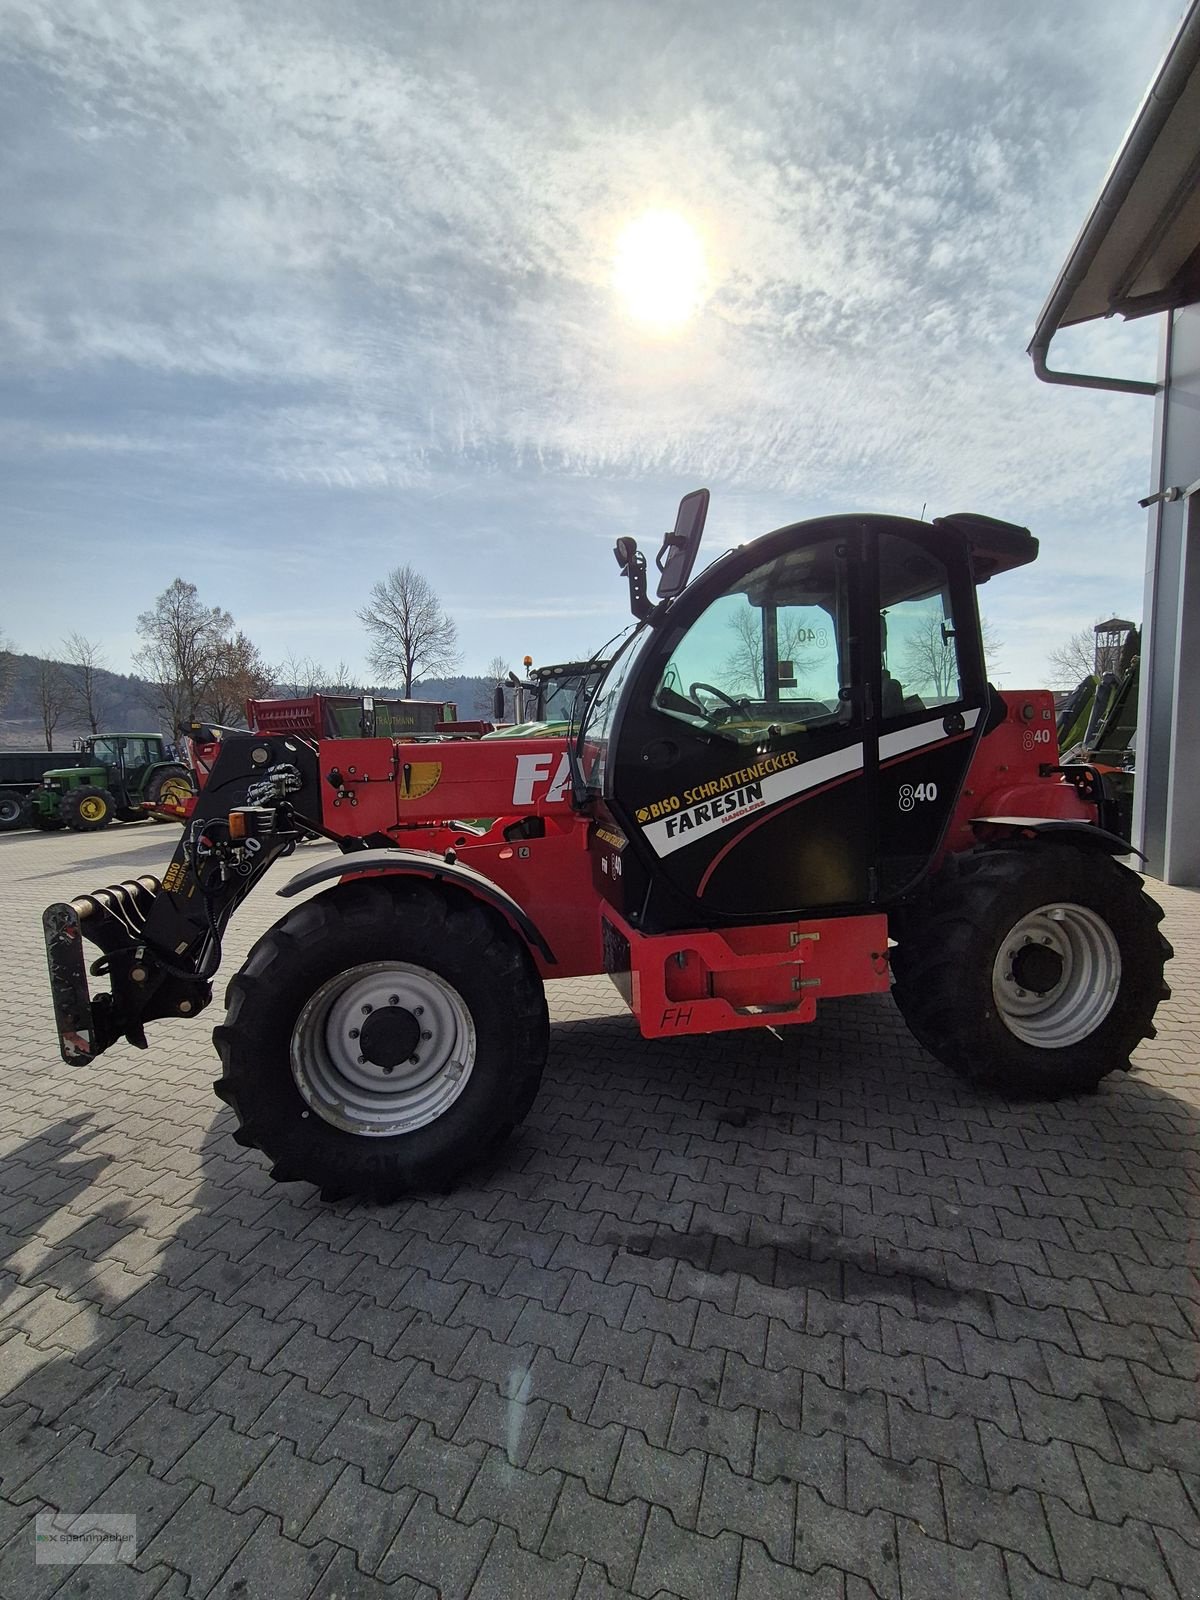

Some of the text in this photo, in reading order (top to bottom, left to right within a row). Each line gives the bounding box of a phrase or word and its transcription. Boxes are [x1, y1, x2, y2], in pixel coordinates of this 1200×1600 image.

[1023, 729, 1050, 750] 840
[650, 751, 799, 819] BISO SCHRATTENECKER
[899, 783, 937, 811] 840
[665, 781, 764, 838] FARESIN
[721, 800, 766, 824] HANDLERS
[169, 863, 181, 886] BISO
[660, 1007, 693, 1029] FH
